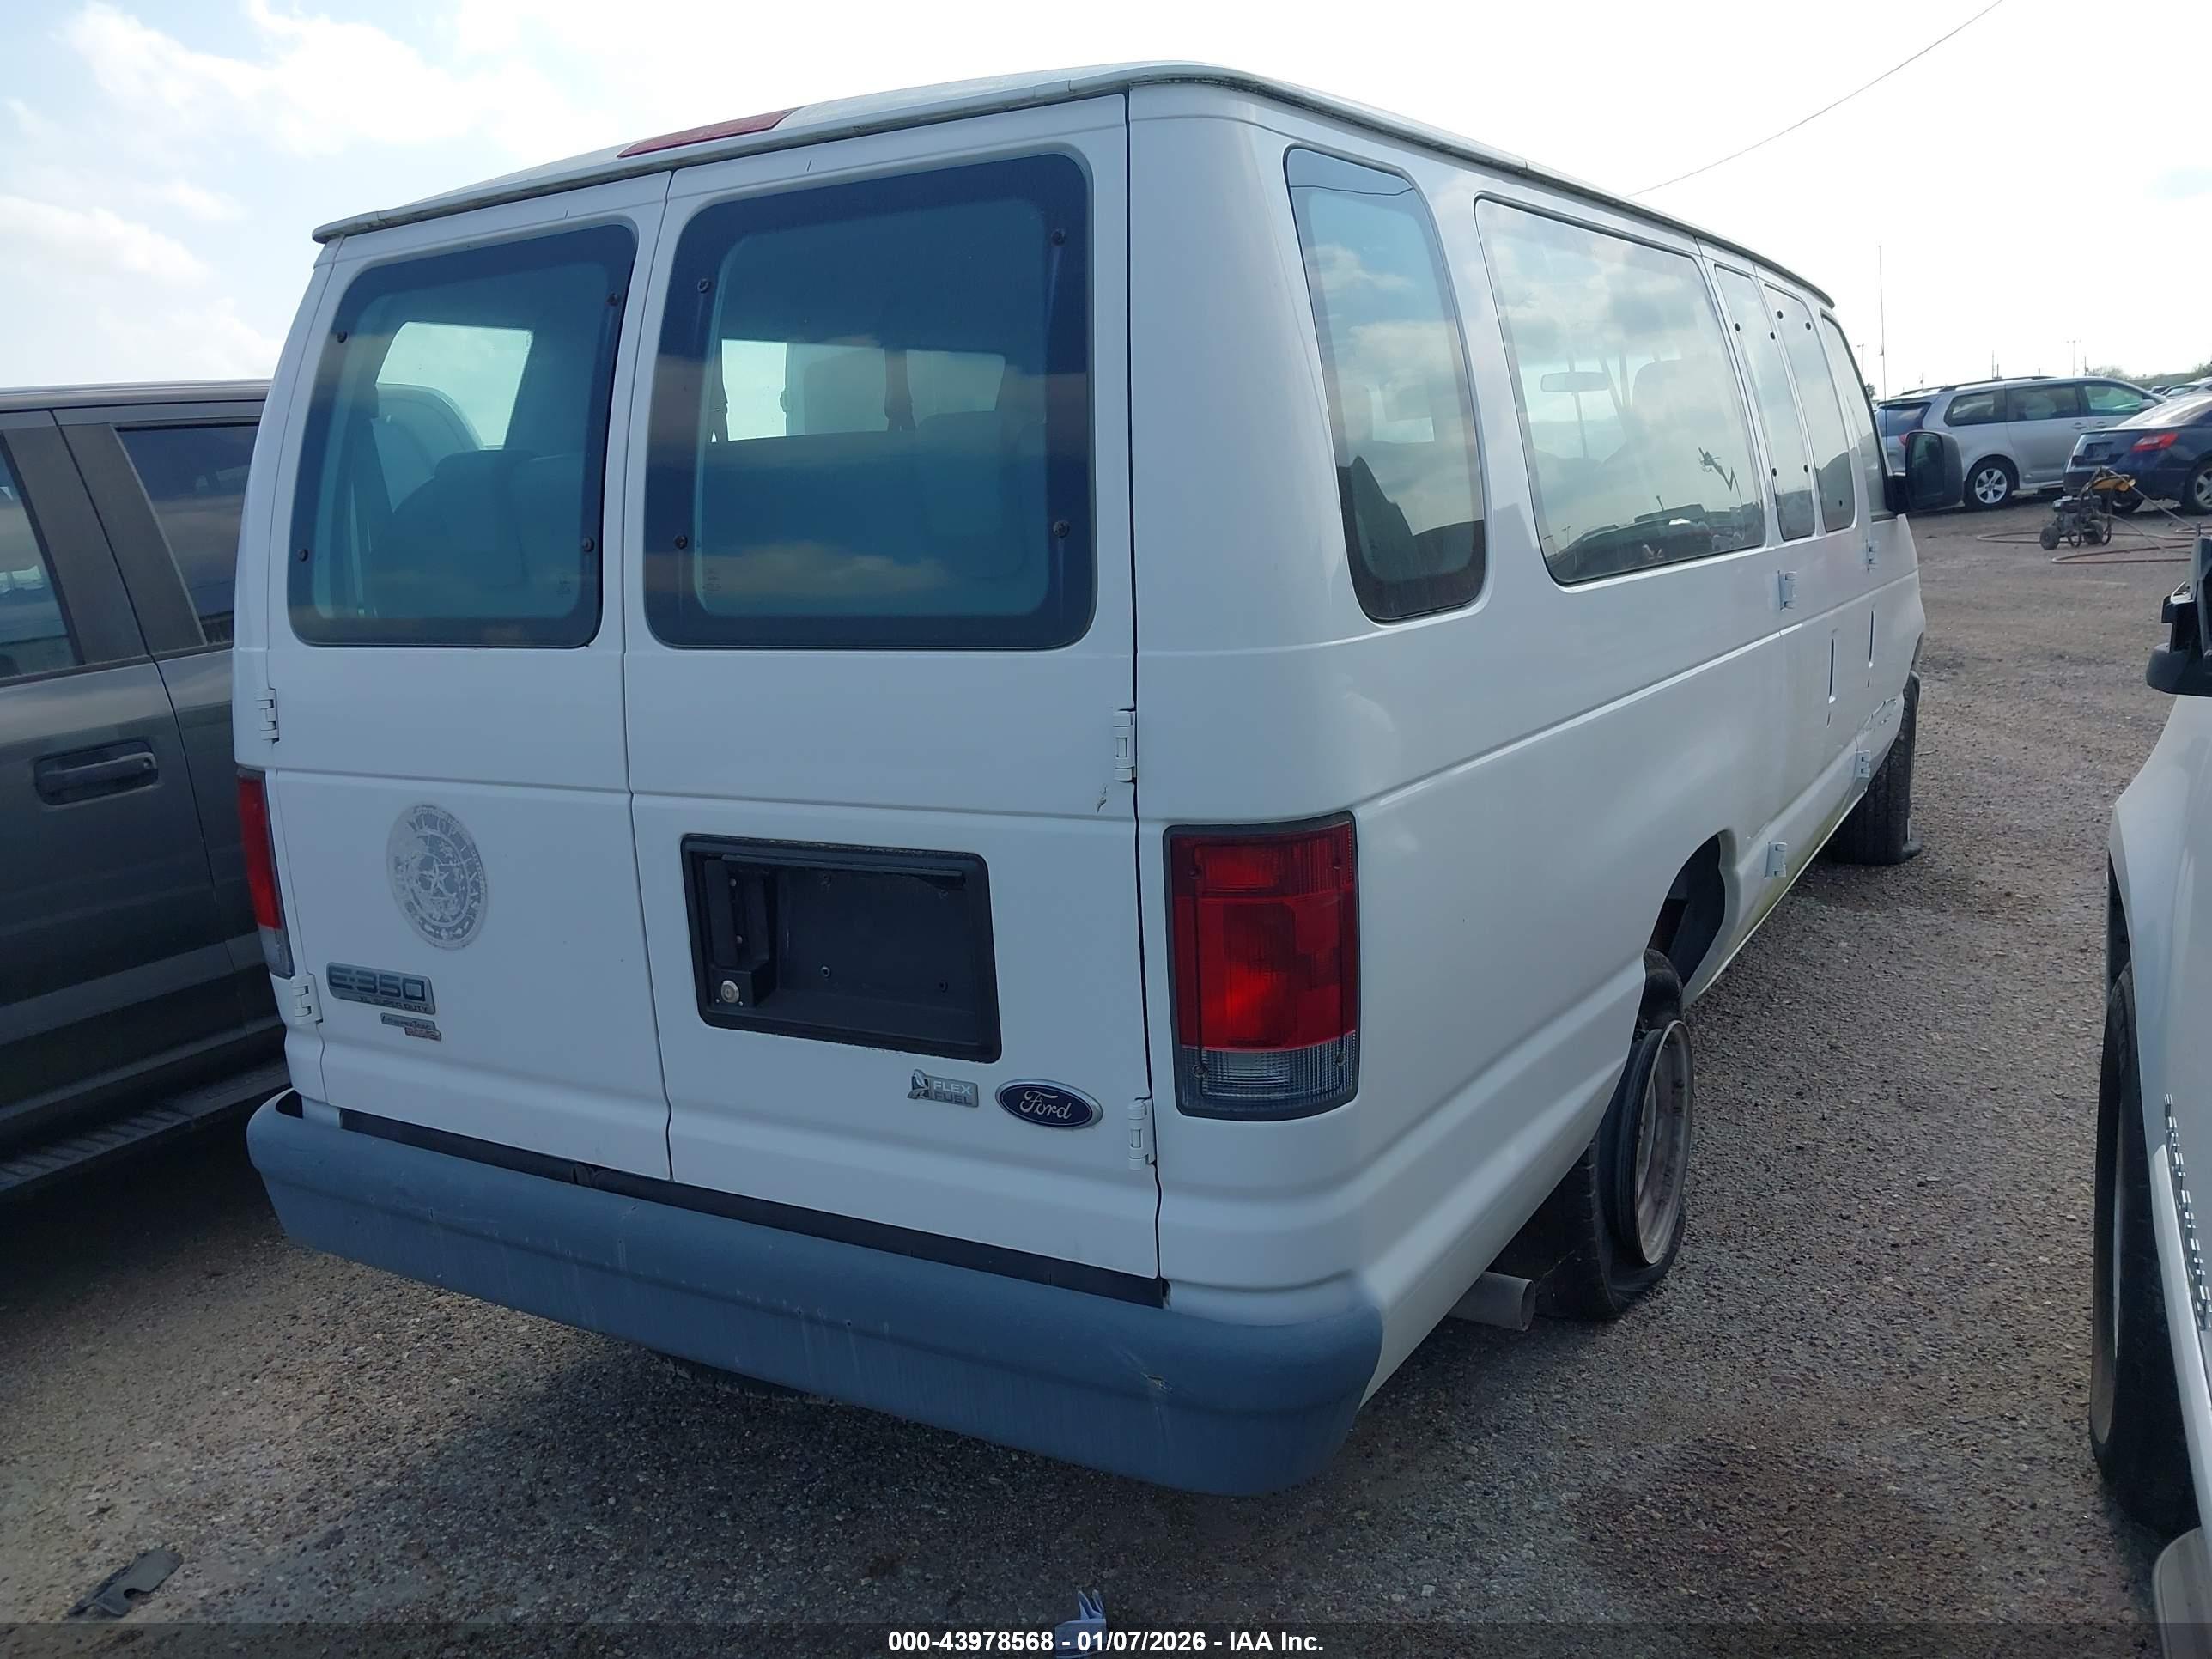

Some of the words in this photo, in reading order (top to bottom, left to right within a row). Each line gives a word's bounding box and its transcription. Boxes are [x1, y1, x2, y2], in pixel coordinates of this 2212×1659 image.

[933, 1079, 972, 1096] FLEX
[933, 1092, 973, 1106] FUEL
[1019, 1090, 1073, 1120] Ford
